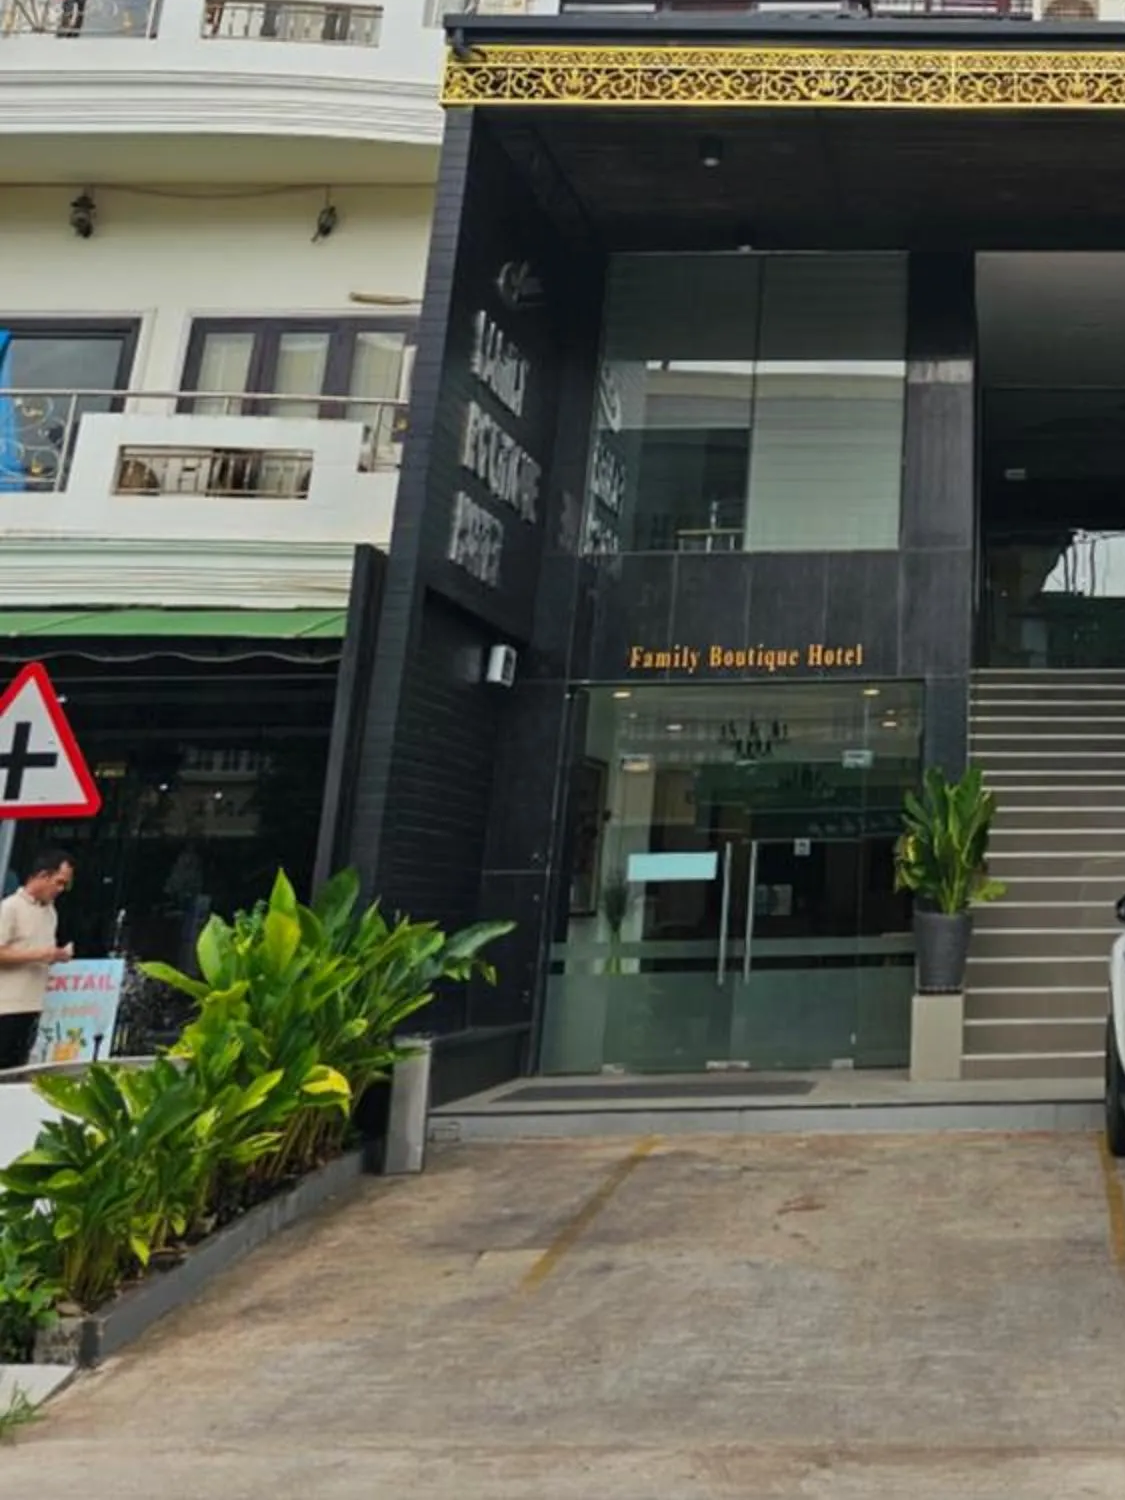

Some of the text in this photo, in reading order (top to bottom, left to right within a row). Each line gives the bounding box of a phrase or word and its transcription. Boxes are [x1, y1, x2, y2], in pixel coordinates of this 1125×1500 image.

[629, 643, 864, 673] Family Boutique Hotel
[46, 974, 116, 990] CKTAIL
